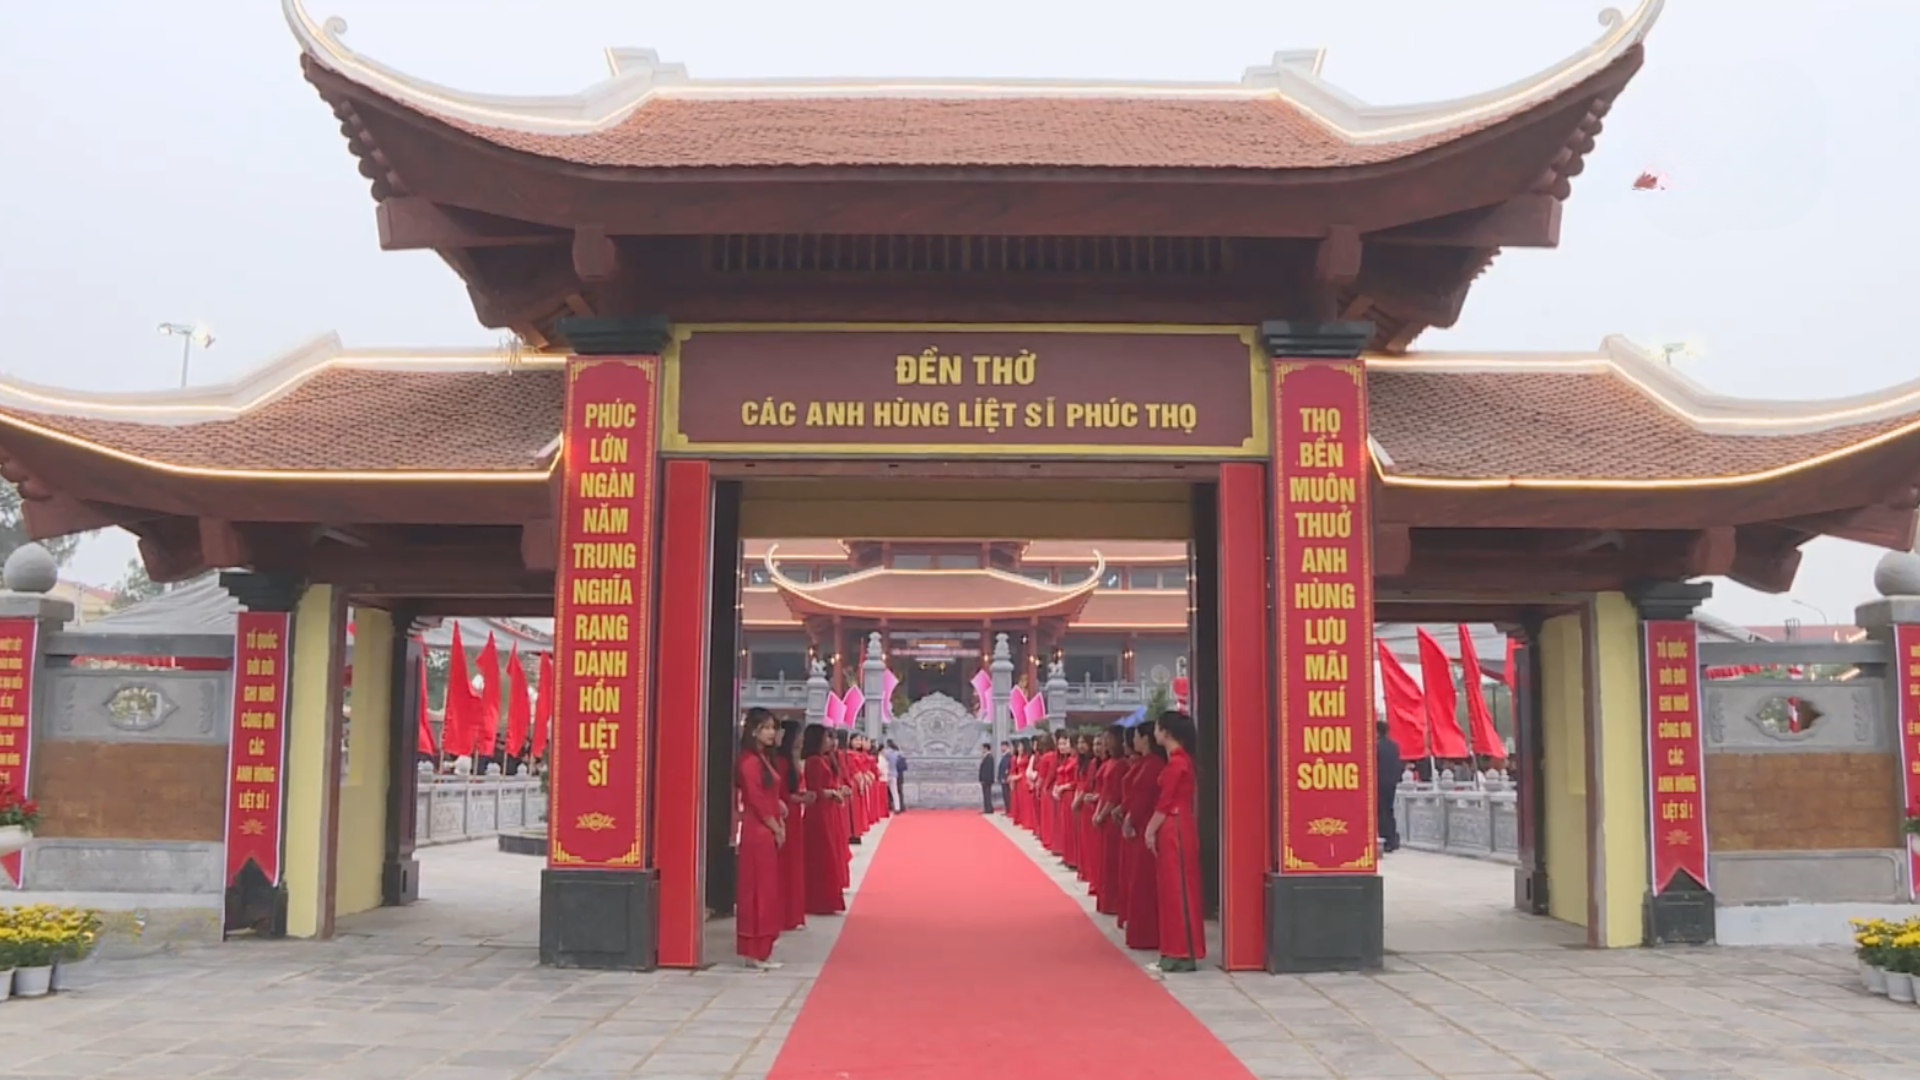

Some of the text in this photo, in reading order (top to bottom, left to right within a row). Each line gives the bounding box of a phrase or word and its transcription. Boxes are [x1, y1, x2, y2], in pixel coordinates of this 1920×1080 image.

[895, 346, 1037, 385] ĐỀN THỜ
[585, 398, 636, 428] PHÚC
[741, 396, 796, 426] CÁC
[805, 401, 865, 427] ANH
[873, 397, 949, 427] HÙNG
[1066, 397, 1138, 428] PHÚC
[1144, 403, 1197, 434] THỌ
[1299, 407, 1341, 439] THỌ
[590, 431, 628, 463] LỚN
[1299, 434, 1344, 468] BỀN
[580, 466, 634, 498] NGÀN
[1289, 472, 1356, 503] MUÔN
[583, 502, 629, 533] NĂM
[1294, 504, 1352, 538] THUỞ
[573, 543, 636, 569] TRUNG
[1301, 547, 1348, 573] ANH
[573, 574, 633, 605] NGHĨA
[1295, 577, 1356, 609] HÙNG
[575, 614, 629, 646] RẠNG
[1305, 616, 1347, 645] LƯU
[574, 650, 628, 677] DANH
[1305, 650, 1348, 681] MÃI
[1308, 685, 1345, 717] KHÍ
[249, 736, 264, 755] CÁC
[579, 717, 619, 755] LIỆT
[1303, 726, 1352, 753] NON
[1668, 745, 1684, 765] CÁC
[1297, 758, 1359, 790] SÔNG
